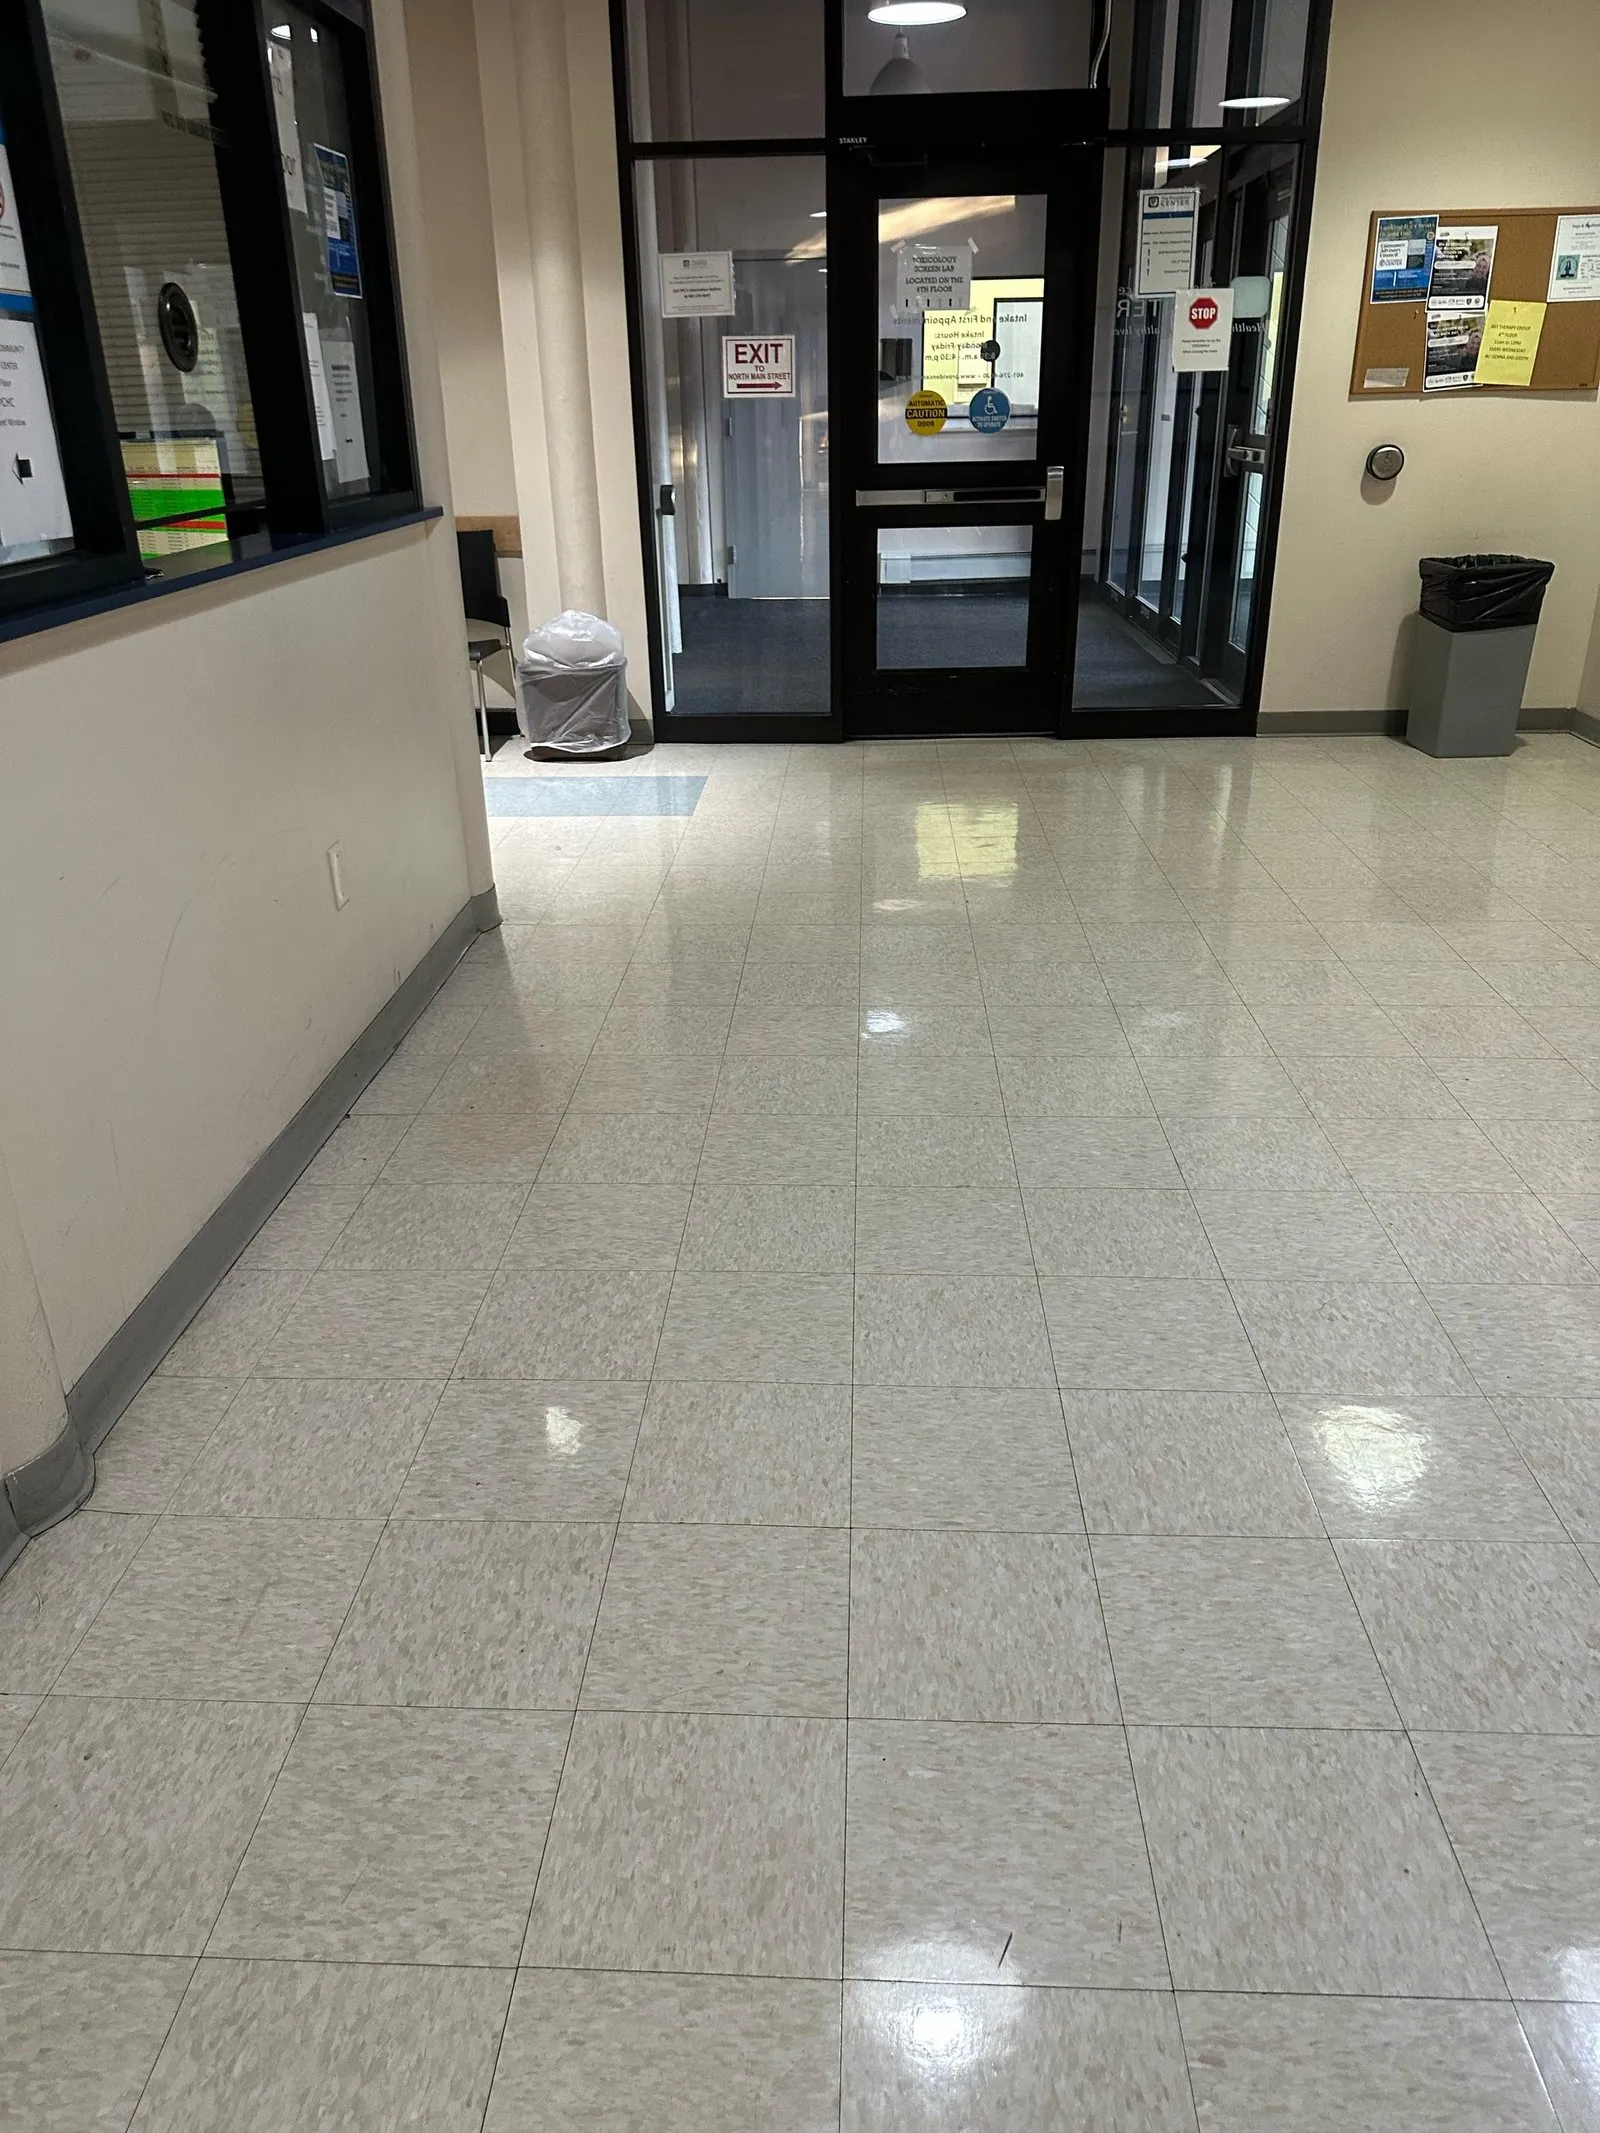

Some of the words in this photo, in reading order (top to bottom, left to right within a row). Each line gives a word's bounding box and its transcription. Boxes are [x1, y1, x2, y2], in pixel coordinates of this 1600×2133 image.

[1191, 307, 1216, 320] STOP
[735, 344, 783, 364] EXIT
[906, 410, 945, 418] CAUTION
